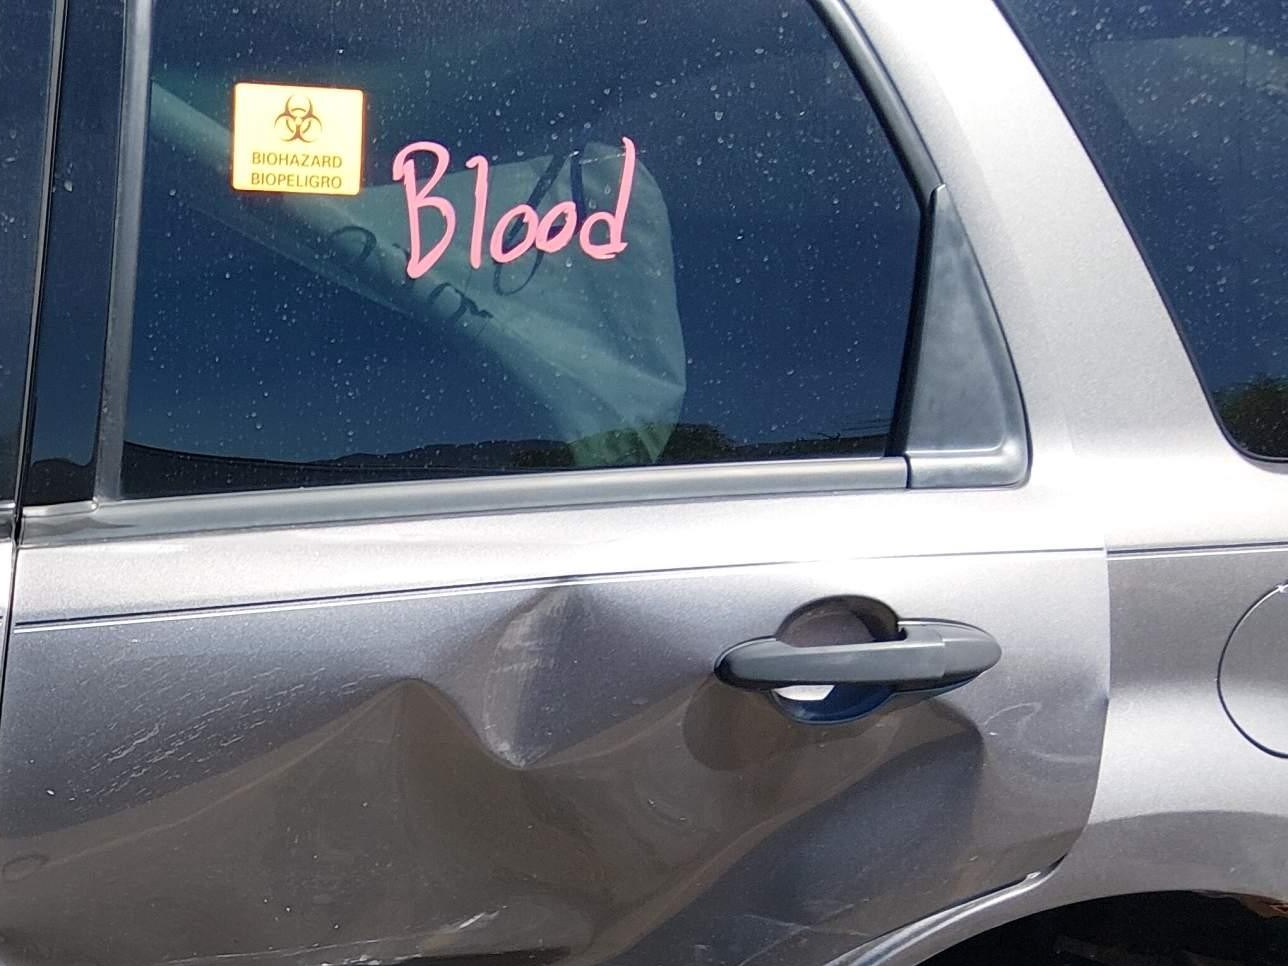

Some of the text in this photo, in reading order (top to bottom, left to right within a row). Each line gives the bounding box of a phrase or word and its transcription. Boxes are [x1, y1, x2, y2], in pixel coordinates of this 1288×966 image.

[252, 151, 343, 169] BIOHAZARD
[250, 172, 343, 189] BIOPELIGRO
[393, 137, 637, 280] Blood
